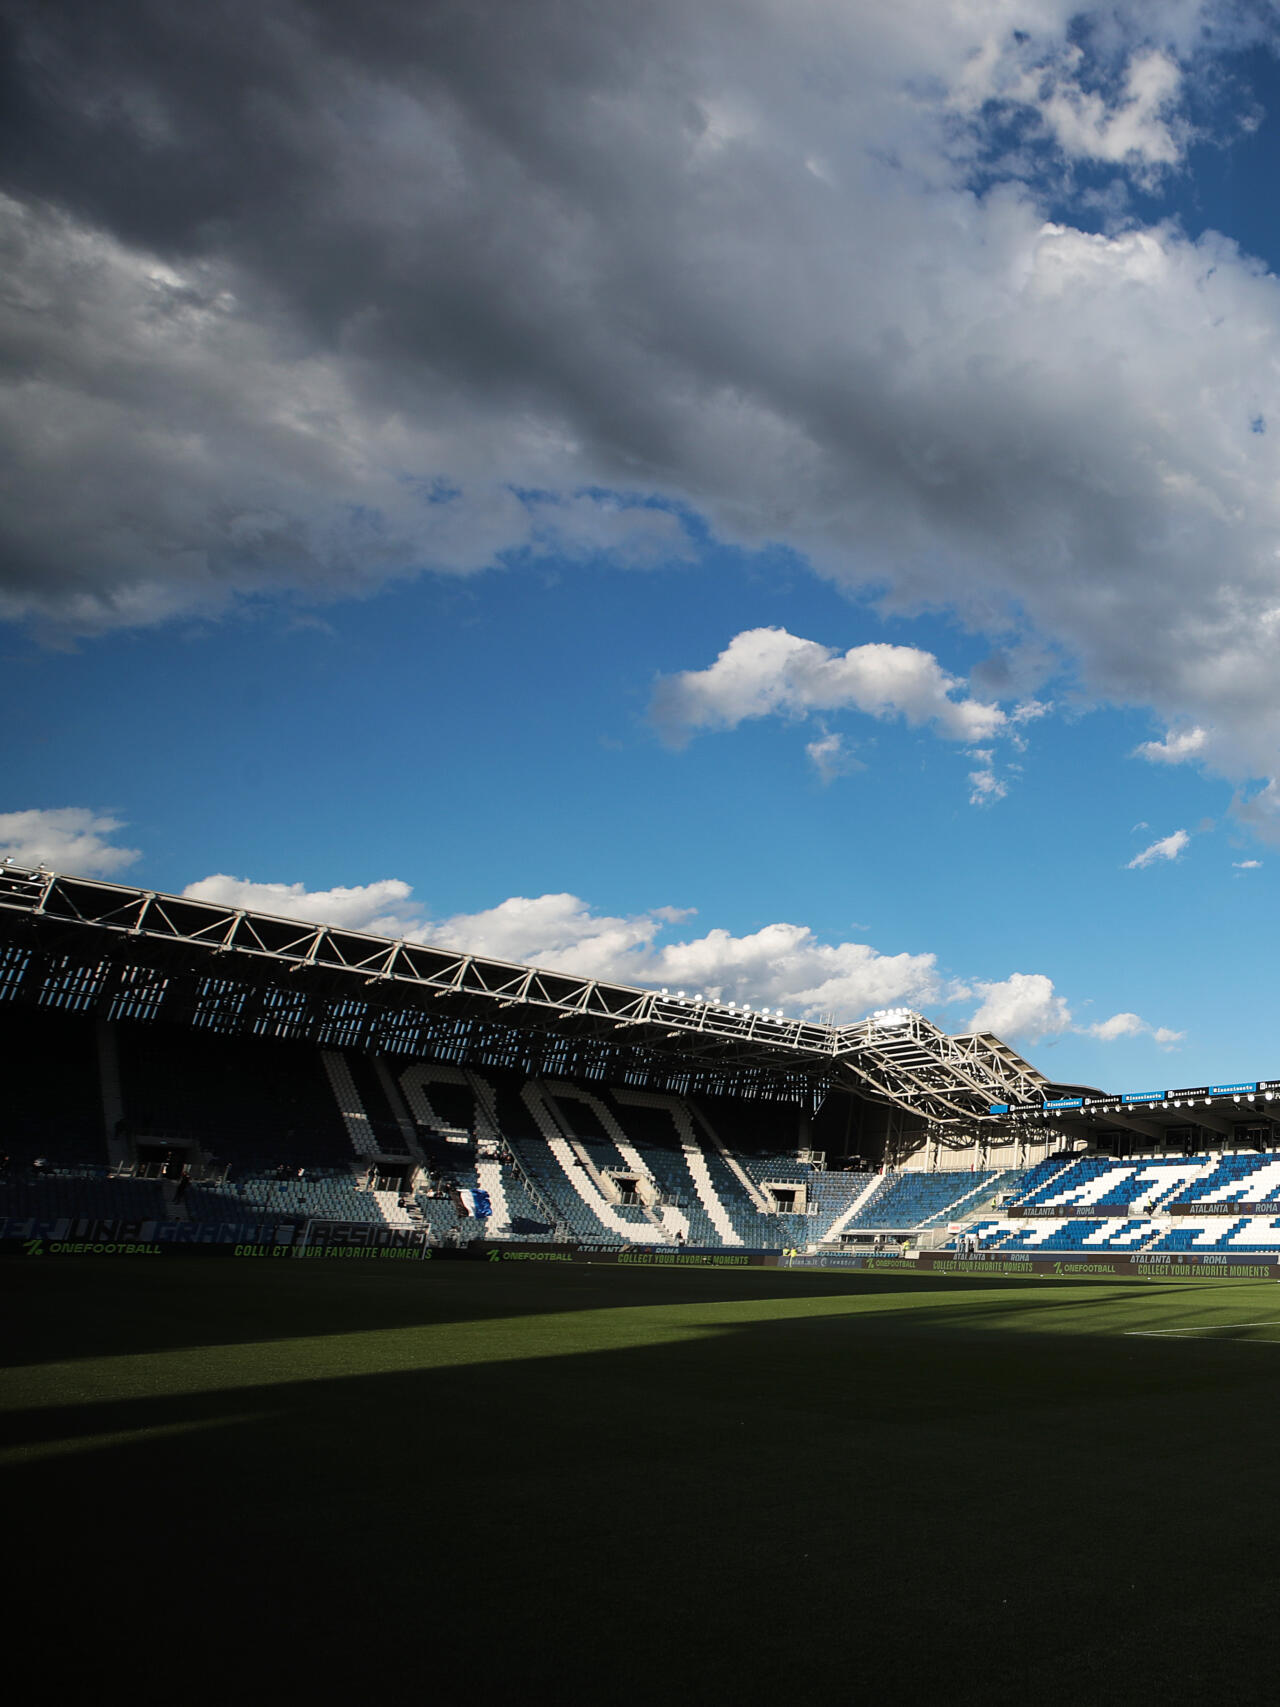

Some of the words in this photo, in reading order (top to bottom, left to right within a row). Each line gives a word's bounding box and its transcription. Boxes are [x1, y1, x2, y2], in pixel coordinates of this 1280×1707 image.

[1023, 1206, 1056, 1216] ATALANTA
[1076, 1206, 1095, 1215] ROMA
[1189, 1204, 1229, 1213] ATALANTA
[1255, 1203, 1278, 1212] ROMA
[49, 1242, 162, 1254] ONEFOOTBALL
[291, 1246, 321, 1257] YUR
[325, 1246, 379, 1258] FAVORITE
[380, 1248, 433, 1259] MOMENS
[503, 1252, 573, 1262] ONEFOOTBALL
[618, 1253, 654, 1263] COLLECT
[655, 1254, 675, 1264] YOUR
[676, 1255, 712, 1265] FAVORITE
[713, 1256, 749, 1265] MOMENTS
[953, 1253, 986, 1261] ATALANTA
[1010, 1253, 1030, 1261] ROMA
[1130, 1255, 1171, 1264] ATALANTA
[1203, 1256, 1227, 1264] ROMA
[933, 1260, 957, 1269] COLLECT
[958, 1261, 974, 1270] YOUR
[975, 1261, 1001, 1271] FAVORITE
[1003, 1262, 1033, 1272] MOMENTS
[1064, 1264, 1116, 1273] ONEFOOTBALL
[1138, 1264, 1169, 1275] COLLECT
[1171, 1265, 1190, 1275] YOUR
[1192, 1265, 1228, 1276] FAVORITE
[1230, 1266, 1270, 1277] MOMENTS
